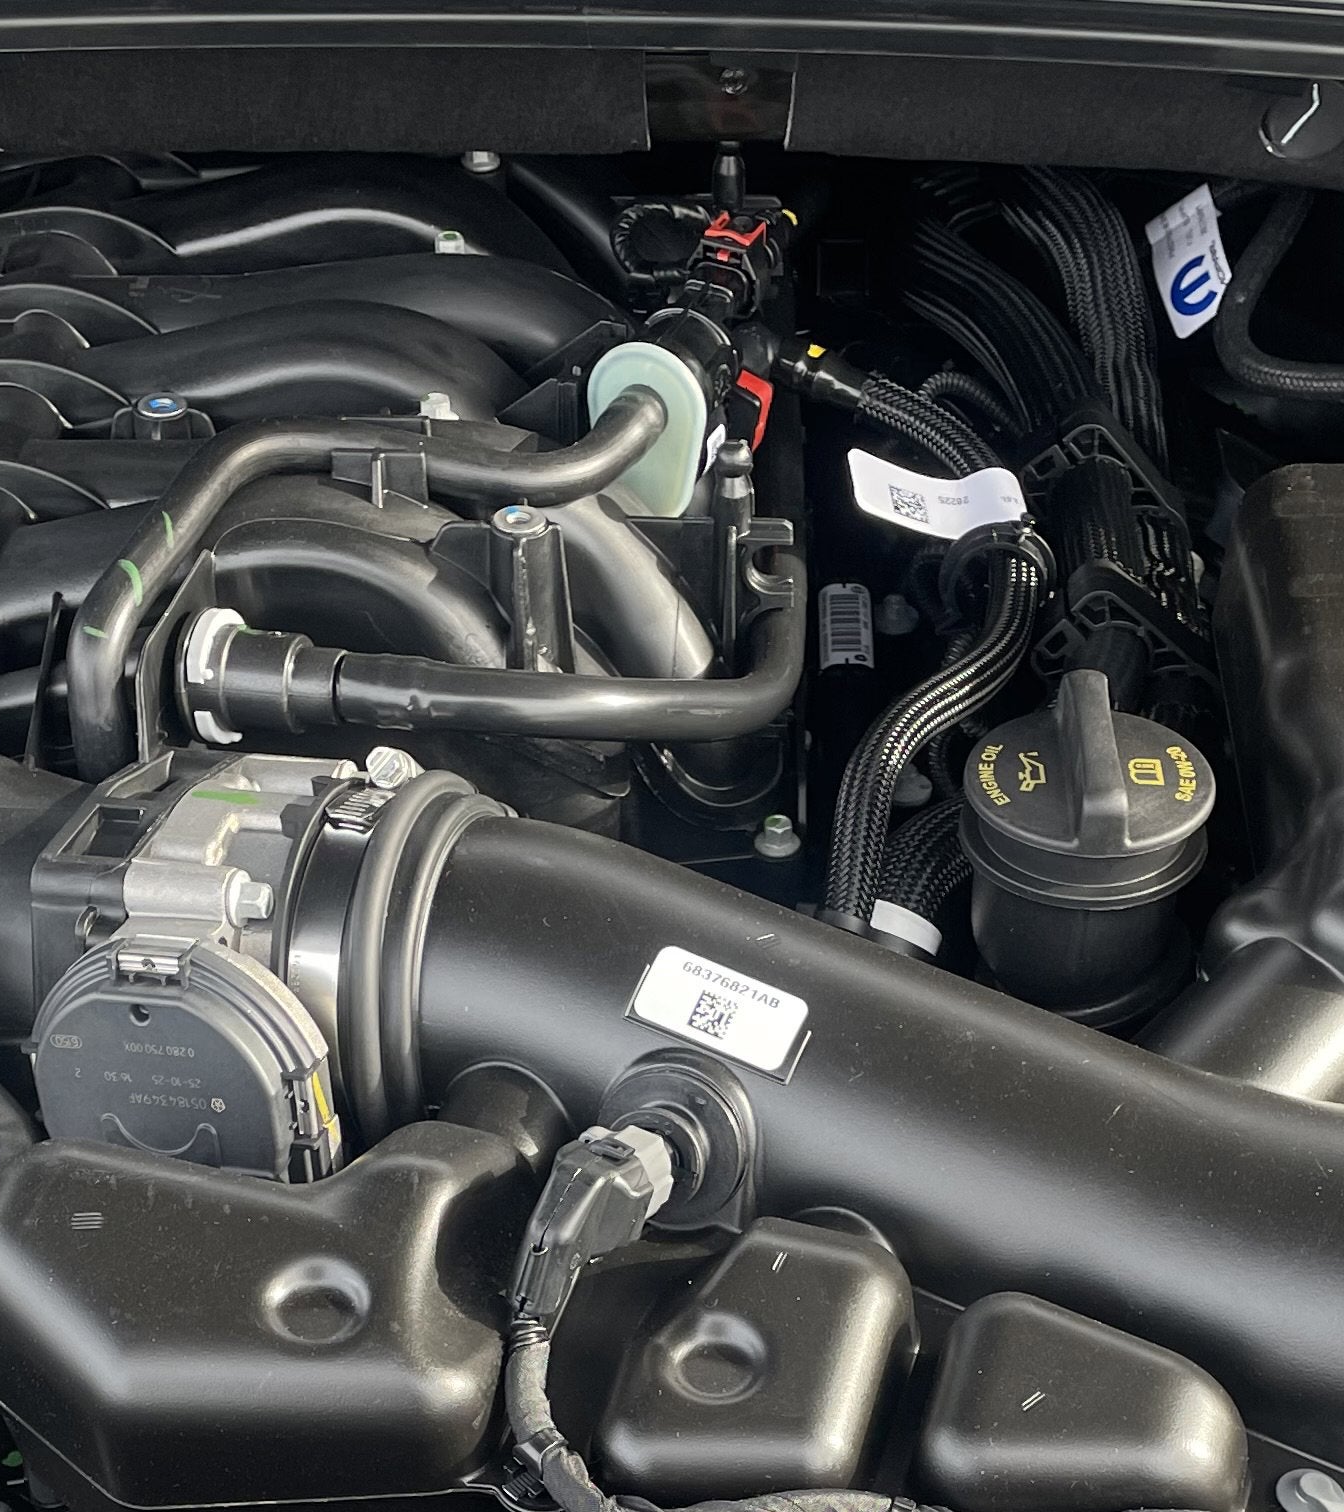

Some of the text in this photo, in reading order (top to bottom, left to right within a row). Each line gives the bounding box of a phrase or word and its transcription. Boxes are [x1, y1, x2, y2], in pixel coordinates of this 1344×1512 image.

[978, 745, 1011, 806] ENGINE OIL
[1174, 778, 1197, 802] SAE
[682, 961, 780, 1008] 68376821AB
